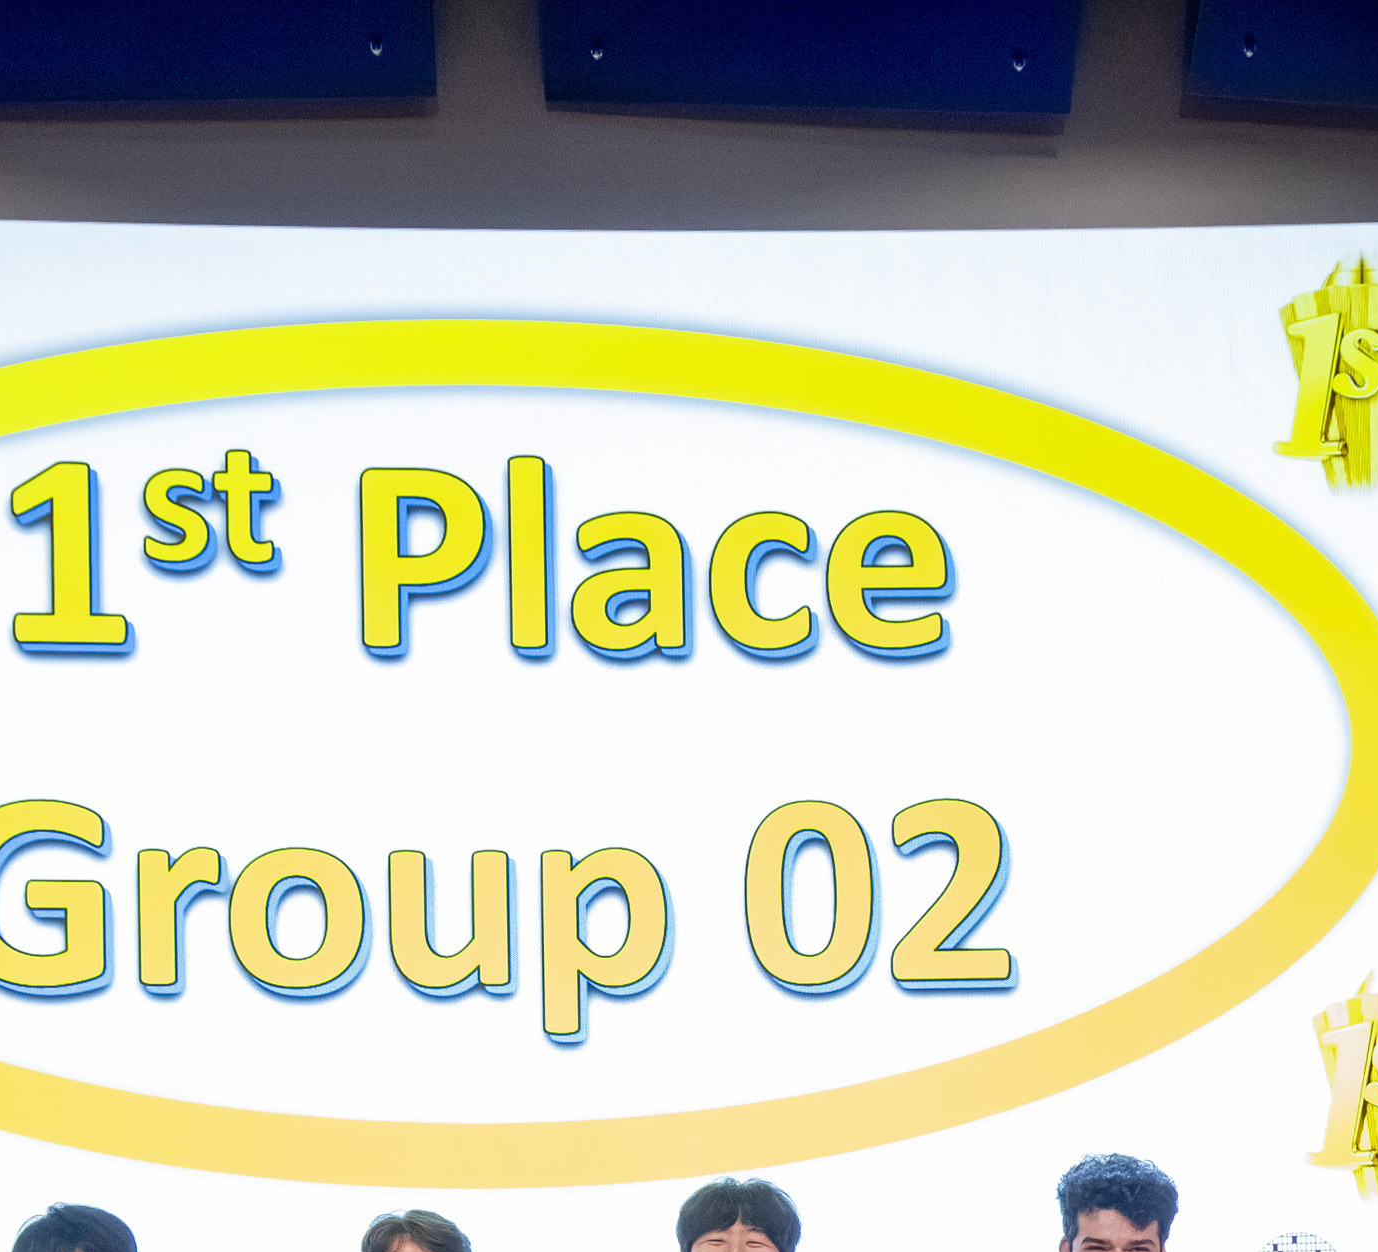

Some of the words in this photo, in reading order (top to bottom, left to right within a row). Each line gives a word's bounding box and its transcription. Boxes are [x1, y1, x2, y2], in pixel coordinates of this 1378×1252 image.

[11, 449, 280, 657] 1st
[359, 455, 954, 660] Place
[744, 798, 1016, 995] 02
